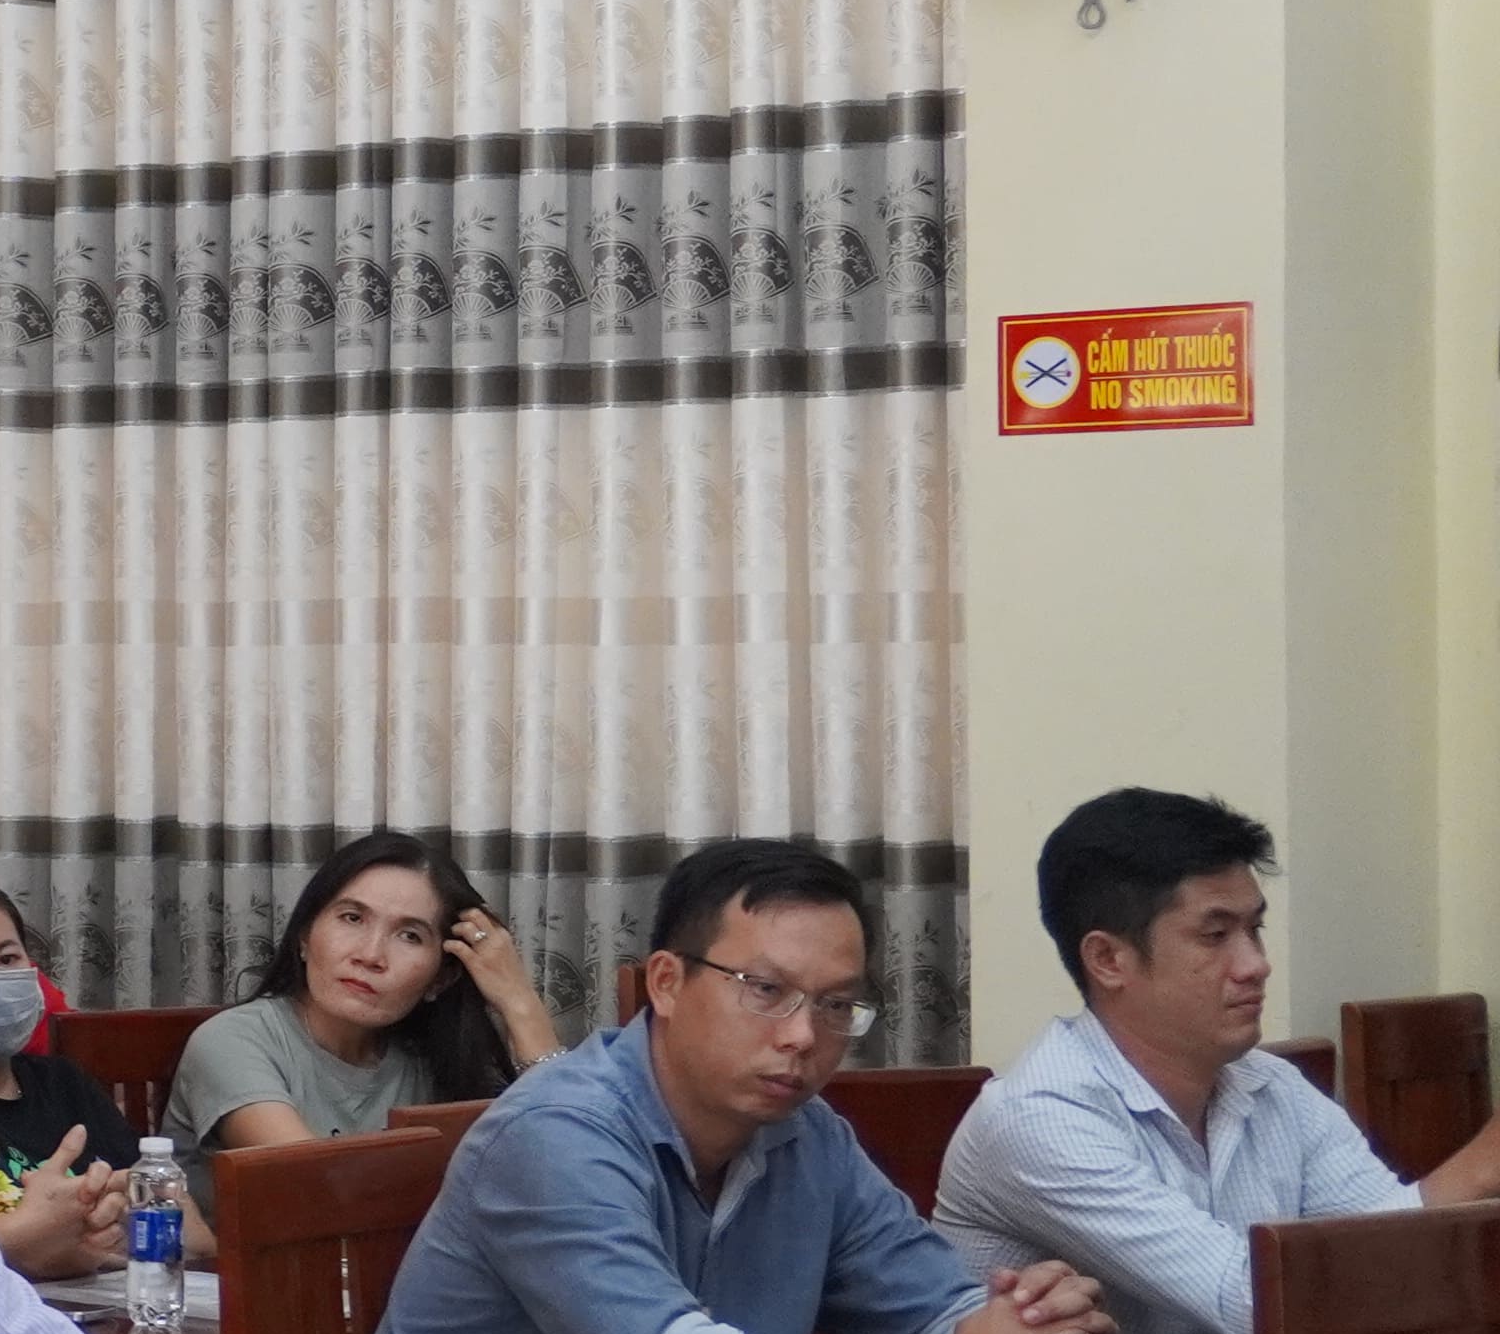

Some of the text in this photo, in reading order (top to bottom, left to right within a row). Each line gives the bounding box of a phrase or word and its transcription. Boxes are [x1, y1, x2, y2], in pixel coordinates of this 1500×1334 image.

[1087, 322, 1236, 374] CẤM HÚT THUỐC
[1090, 374, 1237, 410] NO SMOKING
